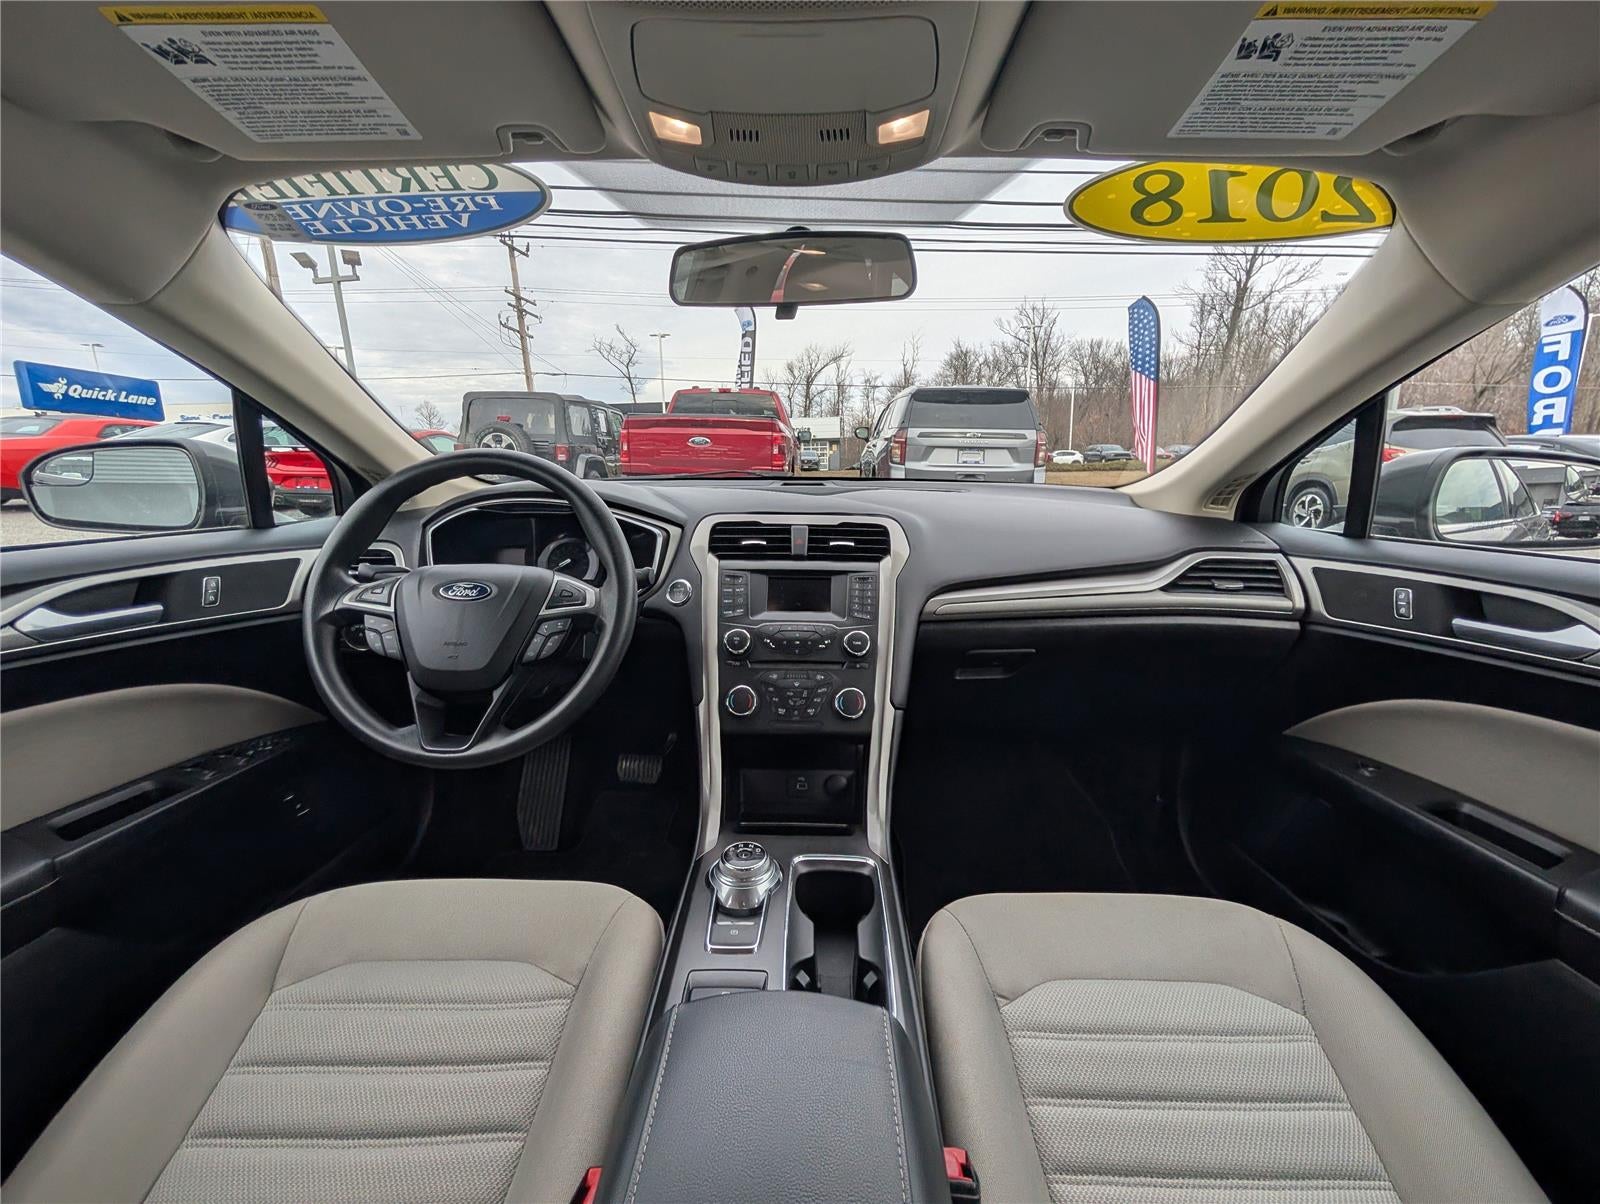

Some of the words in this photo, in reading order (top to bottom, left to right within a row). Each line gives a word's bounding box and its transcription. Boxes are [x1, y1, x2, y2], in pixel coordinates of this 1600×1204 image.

[68, 385, 117, 402] Quick
[119, 391, 157, 406] Lane
[448, 583, 481, 597] Ford
